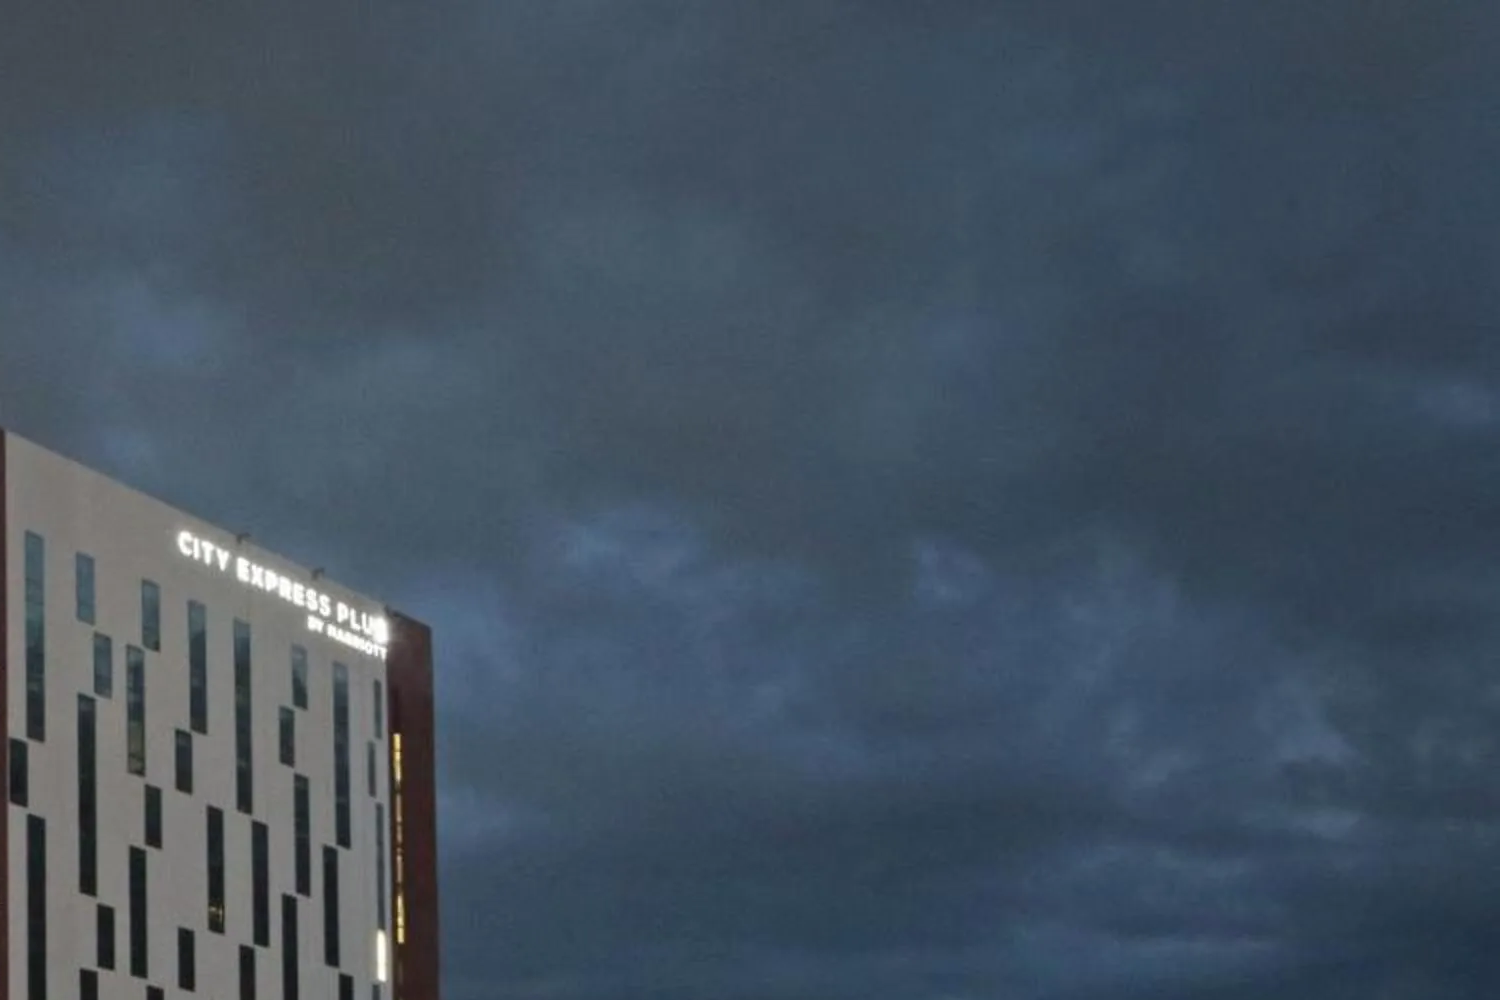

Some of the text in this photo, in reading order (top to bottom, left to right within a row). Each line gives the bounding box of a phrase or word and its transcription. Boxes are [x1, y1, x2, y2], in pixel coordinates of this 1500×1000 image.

[177, 530, 230, 571] CITY
[236, 556, 331, 617] EXPRESS
[307, 615, 324, 633] BY
